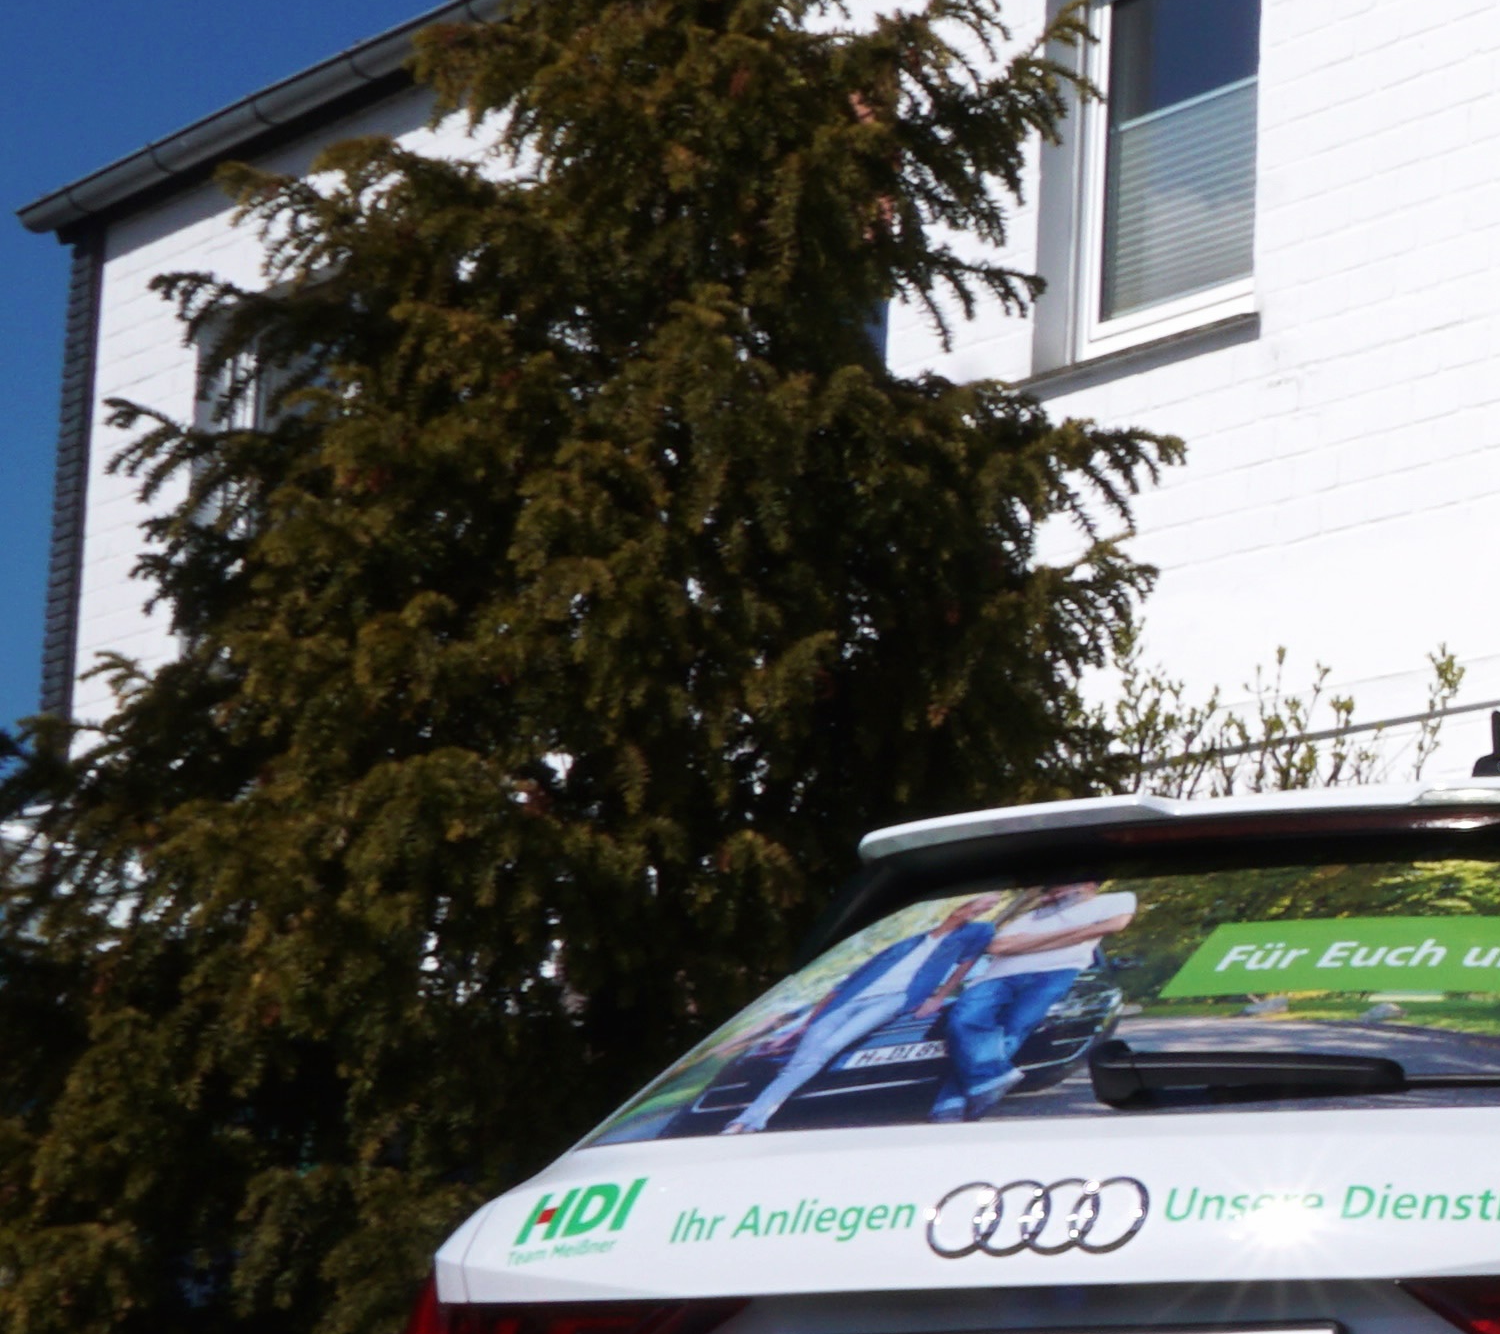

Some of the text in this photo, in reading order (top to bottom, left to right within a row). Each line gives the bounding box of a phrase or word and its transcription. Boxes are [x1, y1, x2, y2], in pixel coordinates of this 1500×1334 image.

[1214, 941, 1309, 973] Für
[1315, 938, 1448, 969] Euch
[515, 1177, 649, 1245] HDI
[670, 1209, 725, 1244] Ihr
[733, 1199, 917, 1243] Anliegen
[507, 1238, 618, 1267] Team Meißner
